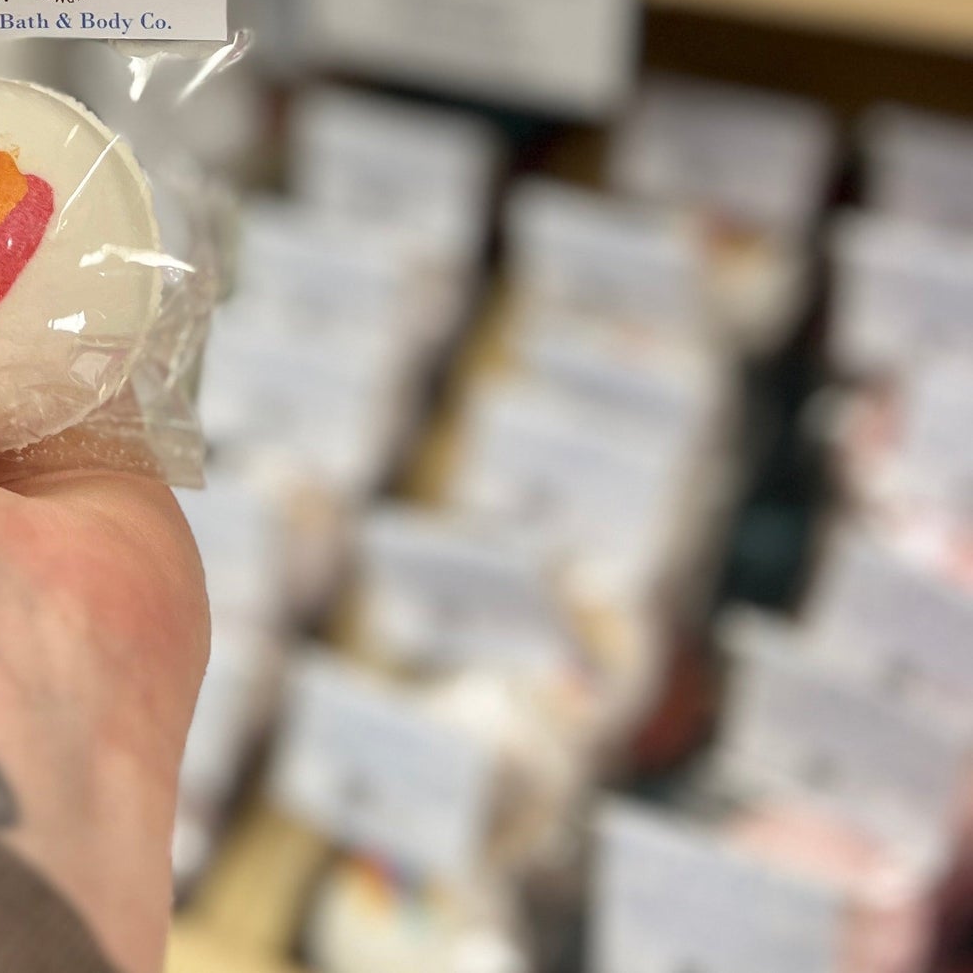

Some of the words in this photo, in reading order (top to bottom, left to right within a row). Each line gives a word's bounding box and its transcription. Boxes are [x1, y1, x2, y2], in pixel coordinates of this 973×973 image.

[0, 13, 49, 29] Bath
[56, 13, 72, 28] &
[80, 13, 133, 34] Body
[141, 13, 171, 29] Co.
